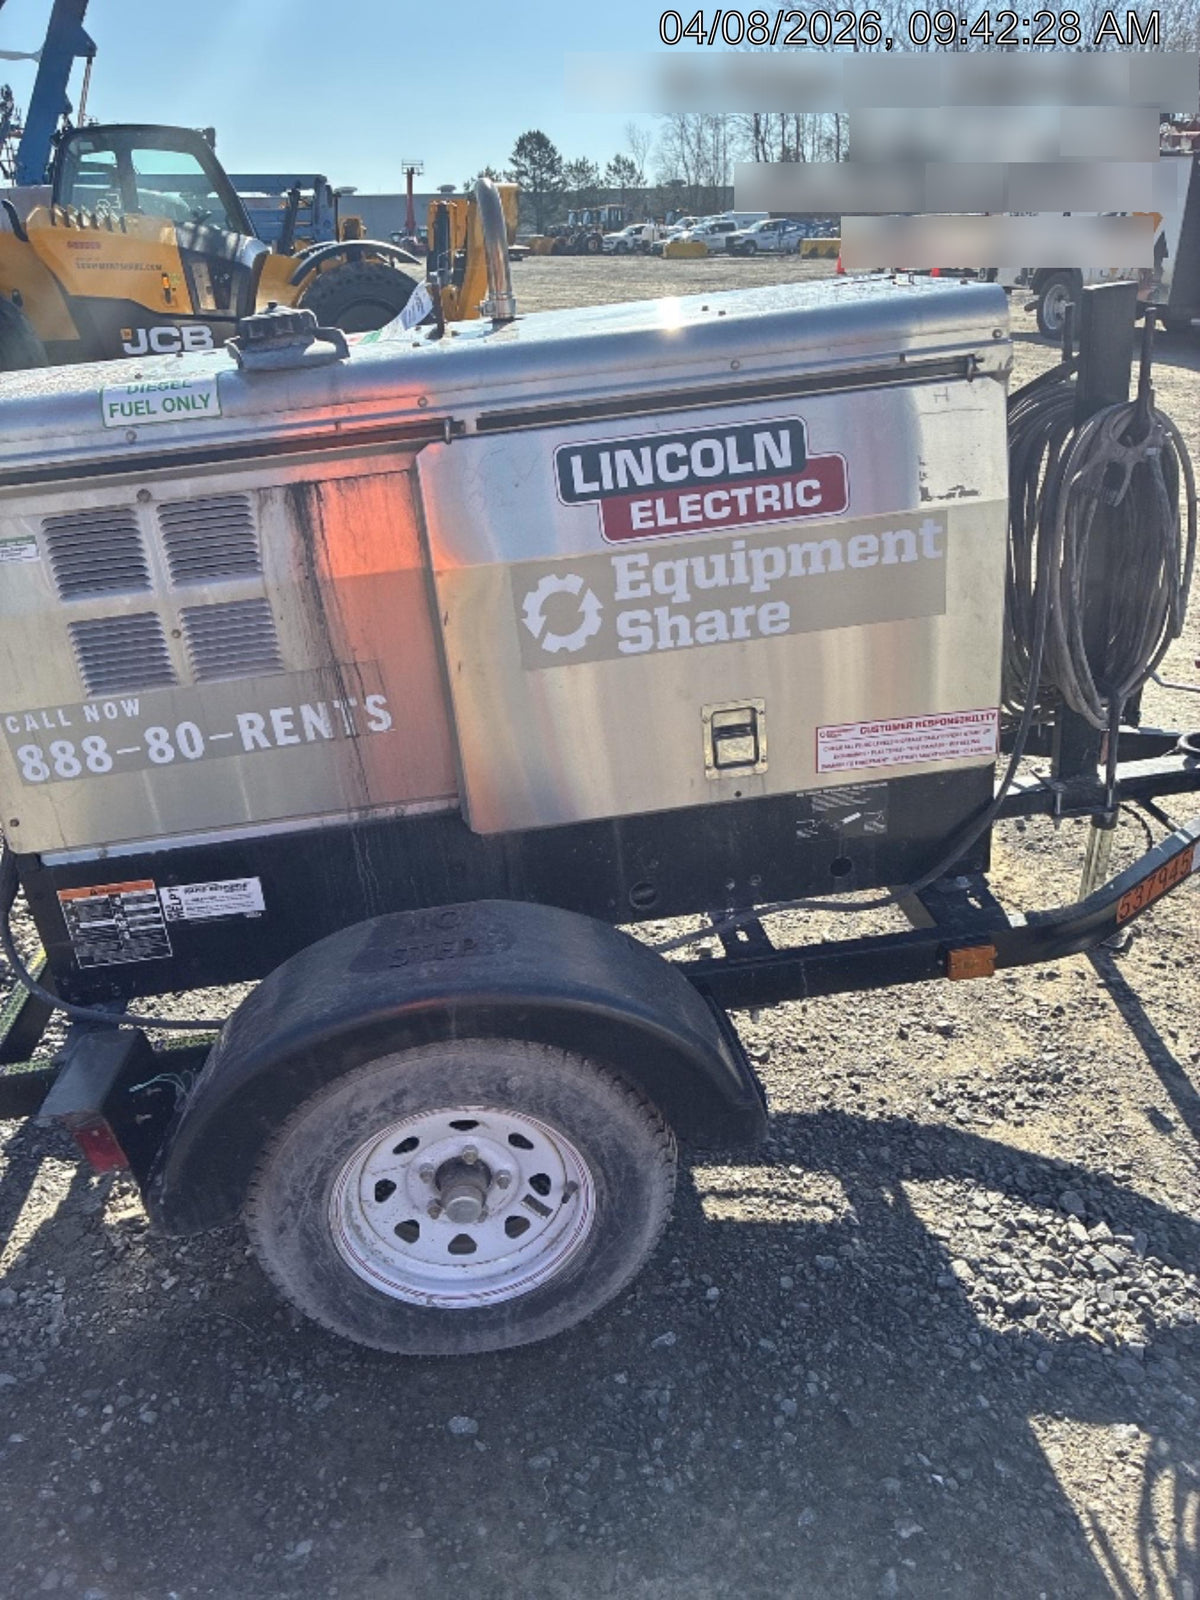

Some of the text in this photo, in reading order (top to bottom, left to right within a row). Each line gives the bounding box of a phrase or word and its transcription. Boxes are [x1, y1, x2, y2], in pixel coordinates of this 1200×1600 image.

[122, 325, 214, 355] JCB
[109, 393, 210, 418] FUEL ONLY
[570, 429, 792, 495] LINCOLN
[630, 479, 822, 531] ELECTRIC
[611, 518, 943, 603] Equipment
[615, 600, 791, 654] Share
[5, 698, 140, 734] CALL NOW
[17, 694, 392, 782] 888-80-RENTS
[860, 721, 913, 735] CUSTOMER
[915, 712, 996, 728] RESPONSIBILITY
